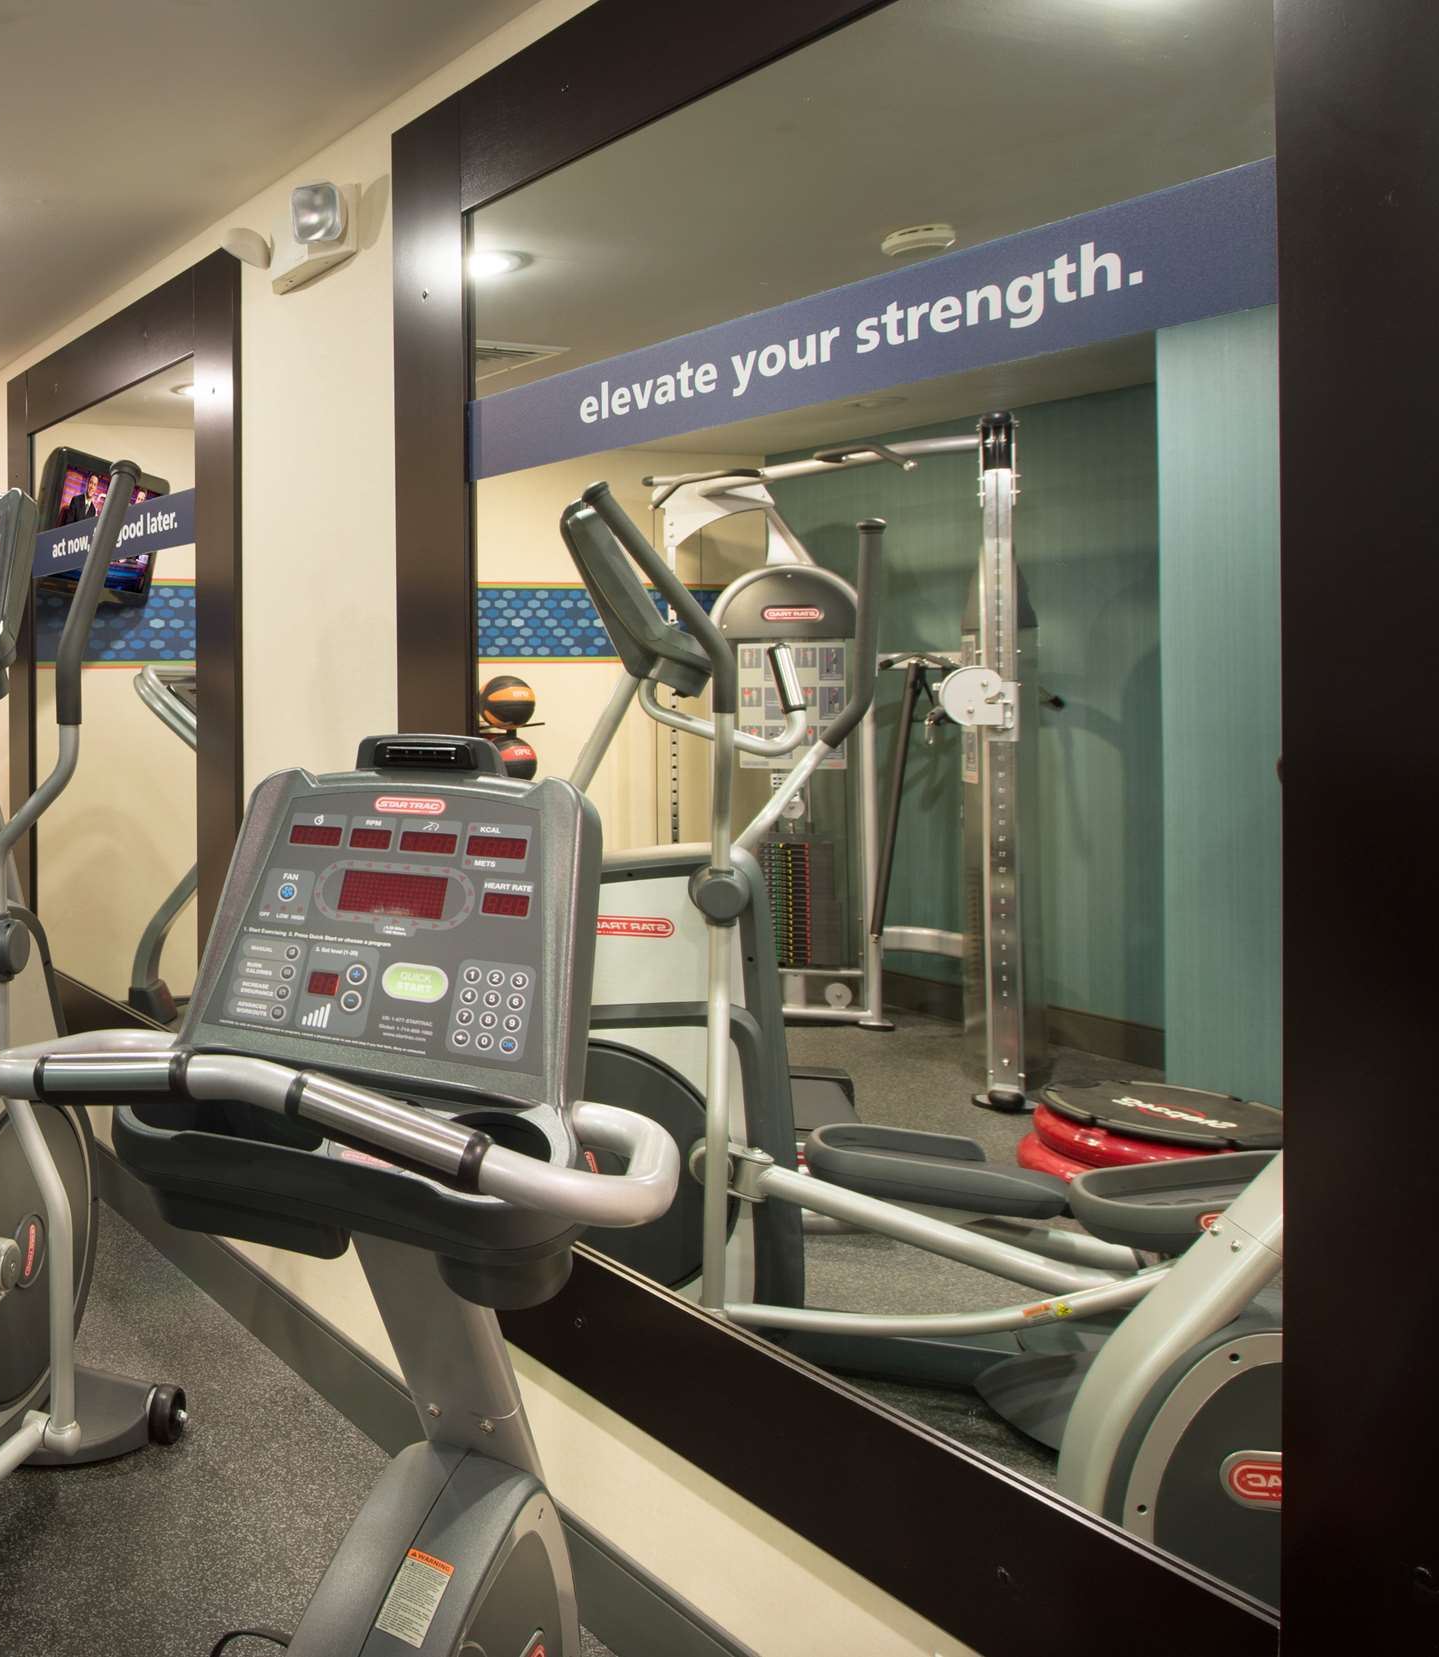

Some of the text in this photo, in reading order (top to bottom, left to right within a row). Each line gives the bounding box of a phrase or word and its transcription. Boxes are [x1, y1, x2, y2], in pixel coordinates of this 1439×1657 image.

[579, 241, 1144, 424] elevate your strength.
[52, 536, 67, 558] act
[67, 535, 91, 553] now,
[146, 511, 178, 535] later.
[379, 801, 440, 811] STAR TRAC
[365, 819, 382, 827] RPM
[480, 826, 501, 834] KCAL
[474, 860, 496, 868] METS
[282, 872, 299, 881] FAN
[484, 882, 534, 893] HEART RATE
[399, 971, 433, 984] QUICK
[469, 970, 476, 980] 1
[492, 973, 500, 982] 2
[516, 976, 523, 985] 3
[396, 981, 433, 993] START
[465, 991, 473, 1000] 4
[461, 1012, 469, 1021] 7
[485, 1015, 492, 1024] 8
[509, 1019, 516, 1028] 9
[481, 1037, 488, 1046] 0
[502, 1040, 514, 1050] OK
[417, 1554, 451, 1572] WARNING
